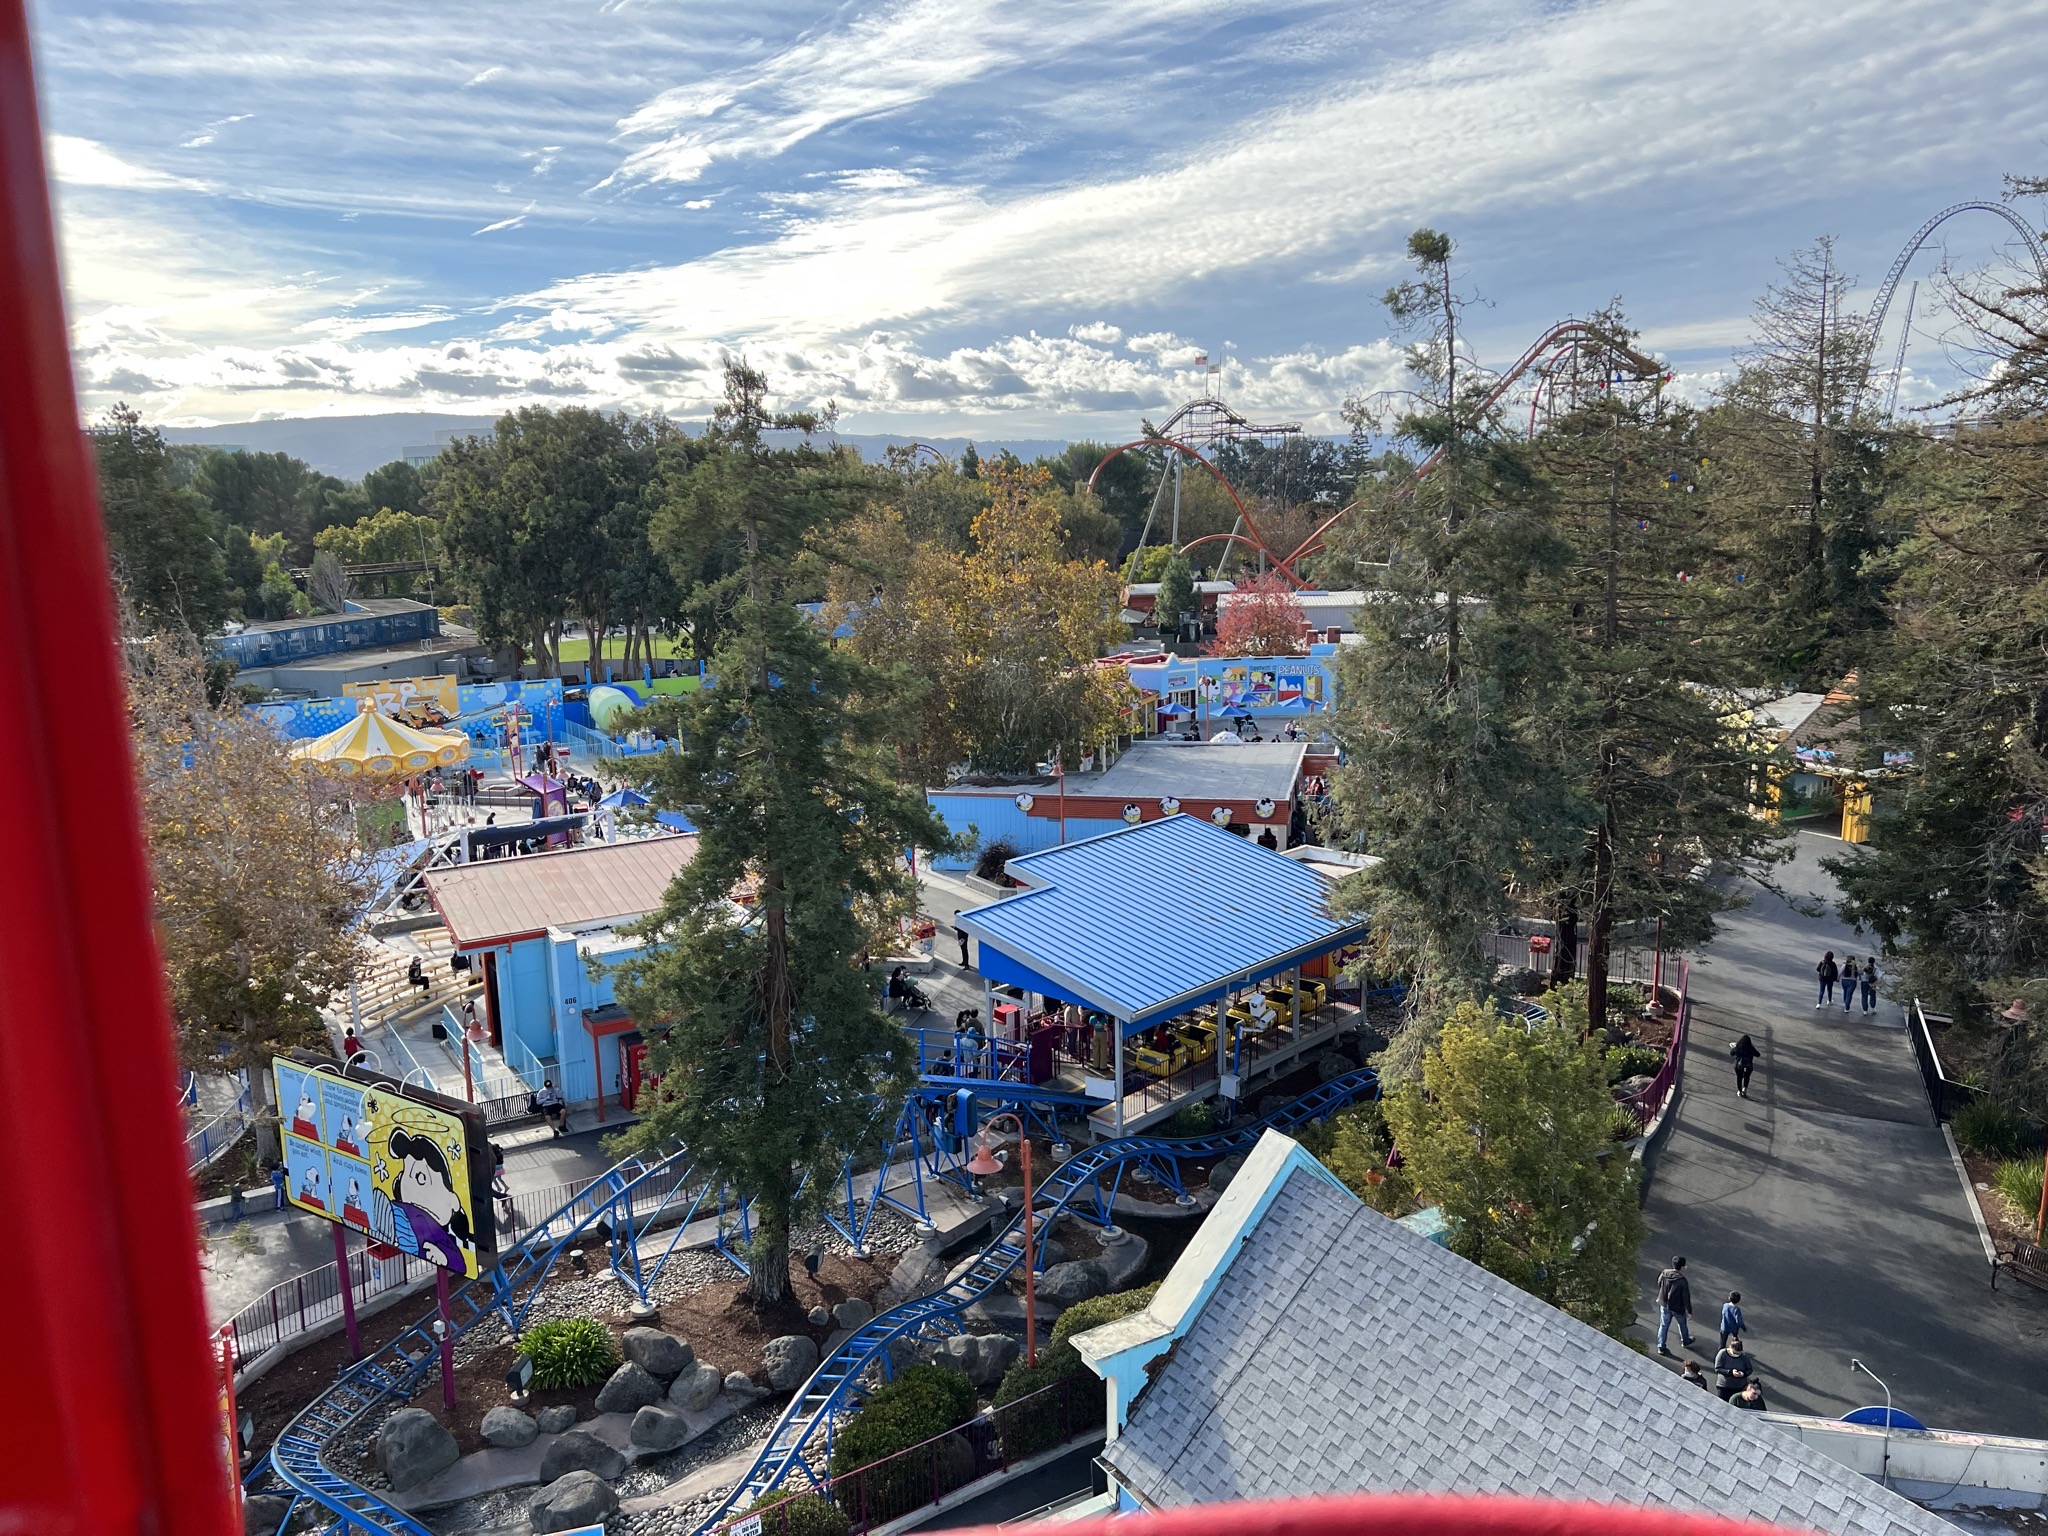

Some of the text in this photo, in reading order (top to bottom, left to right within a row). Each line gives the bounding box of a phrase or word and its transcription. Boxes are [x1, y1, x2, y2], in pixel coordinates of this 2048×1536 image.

[1278, 665, 1321, 676] PEANUTS
[564, 996, 577, 1005] 406
[325, 1082, 336, 1092] How
[336, 1086, 343, 1094] to
[292, 1148, 300, 1156] you
[310, 1146, 322, 1157] what
[332, 1156, 342, 1166] And
[343, 1159, 354, 1172] stay
[730, 1514, 760, 1531] DANGER
[741, 1521, 760, 1534] DO NOT
